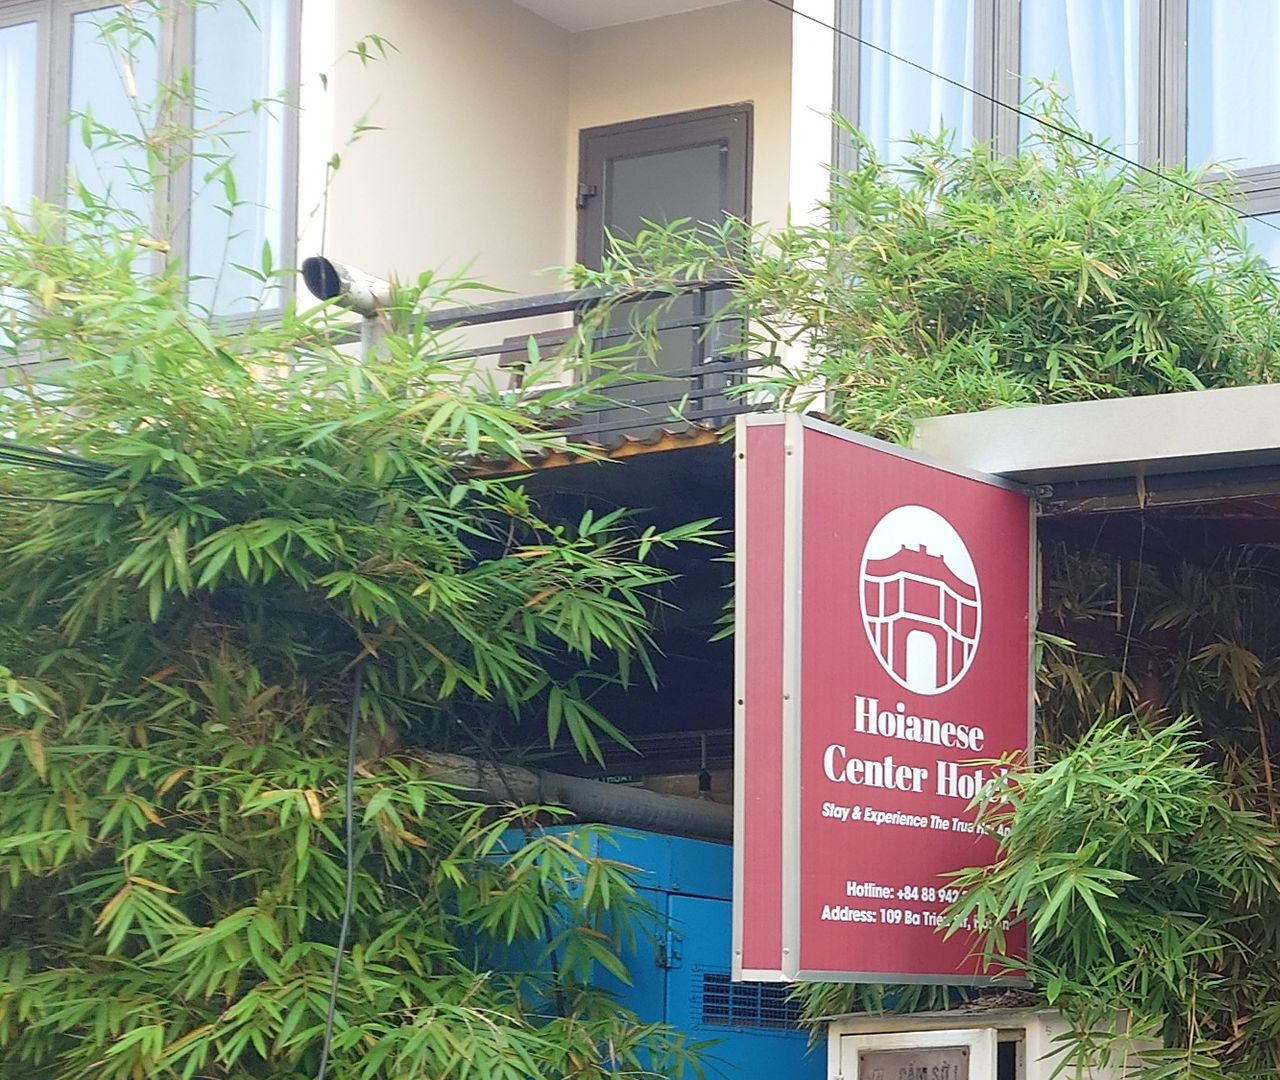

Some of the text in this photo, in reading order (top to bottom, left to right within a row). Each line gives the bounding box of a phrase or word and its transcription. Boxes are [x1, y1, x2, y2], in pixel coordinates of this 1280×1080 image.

[854, 696, 985, 752] Hoianese
[824, 745, 929, 794] Center
[822, 802, 851, 822] Stay
[852, 806, 862, 820] &
[864, 807, 928, 828] Experience
[930, 815, 949, 831] The
[952, 817, 975, 833] True
[846, 881, 894, 899] Hotline:
[897, 885, 918, 901] +84
[921, 887, 935, 902] 88
[821, 905, 876, 923] Address:
[880, 908, 901, 924] 109
[905, 911, 920, 925] Ba
